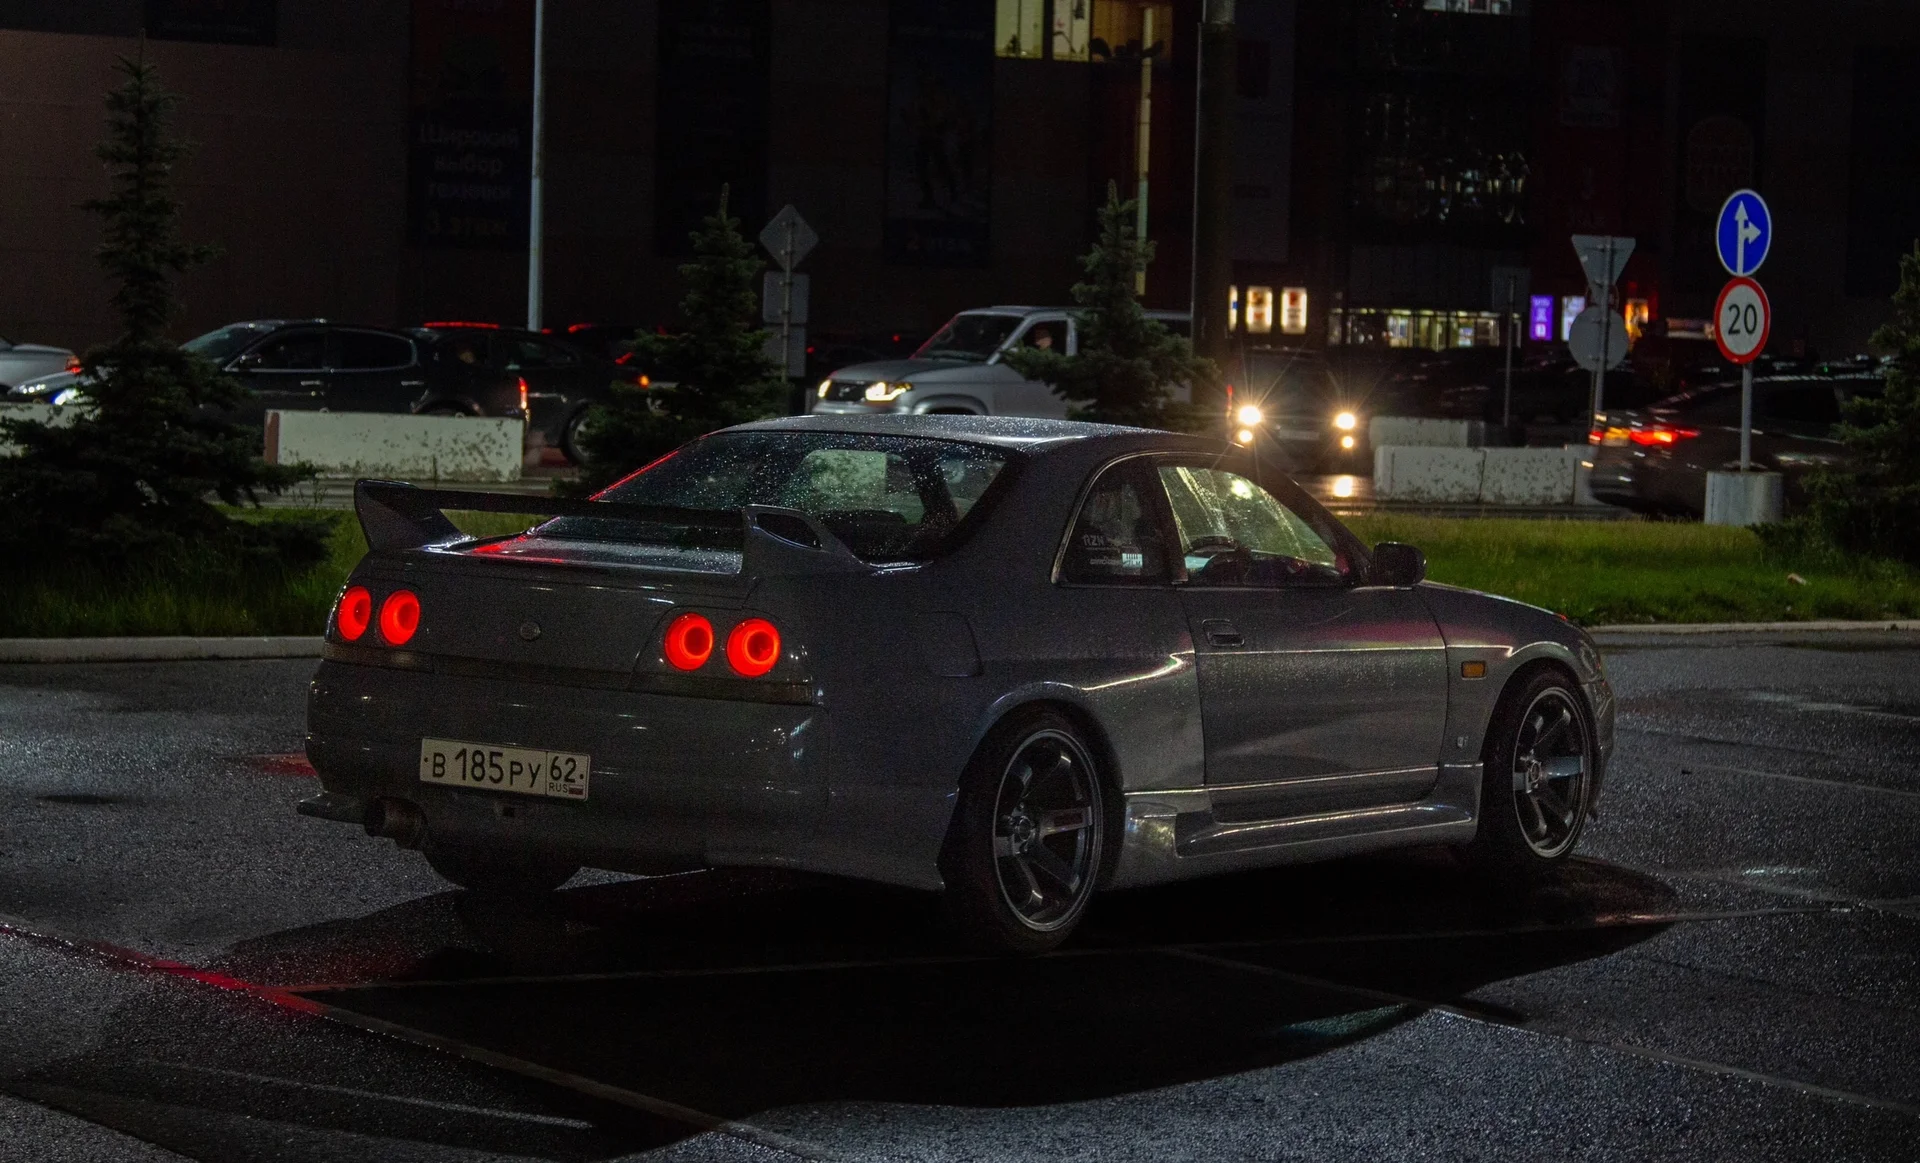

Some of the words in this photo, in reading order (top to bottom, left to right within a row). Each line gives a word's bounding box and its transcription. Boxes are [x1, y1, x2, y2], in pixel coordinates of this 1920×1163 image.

[1728, 303, 1757, 335] 20
[550, 756, 576, 783] 62
[549, 783, 568, 794] RUS
